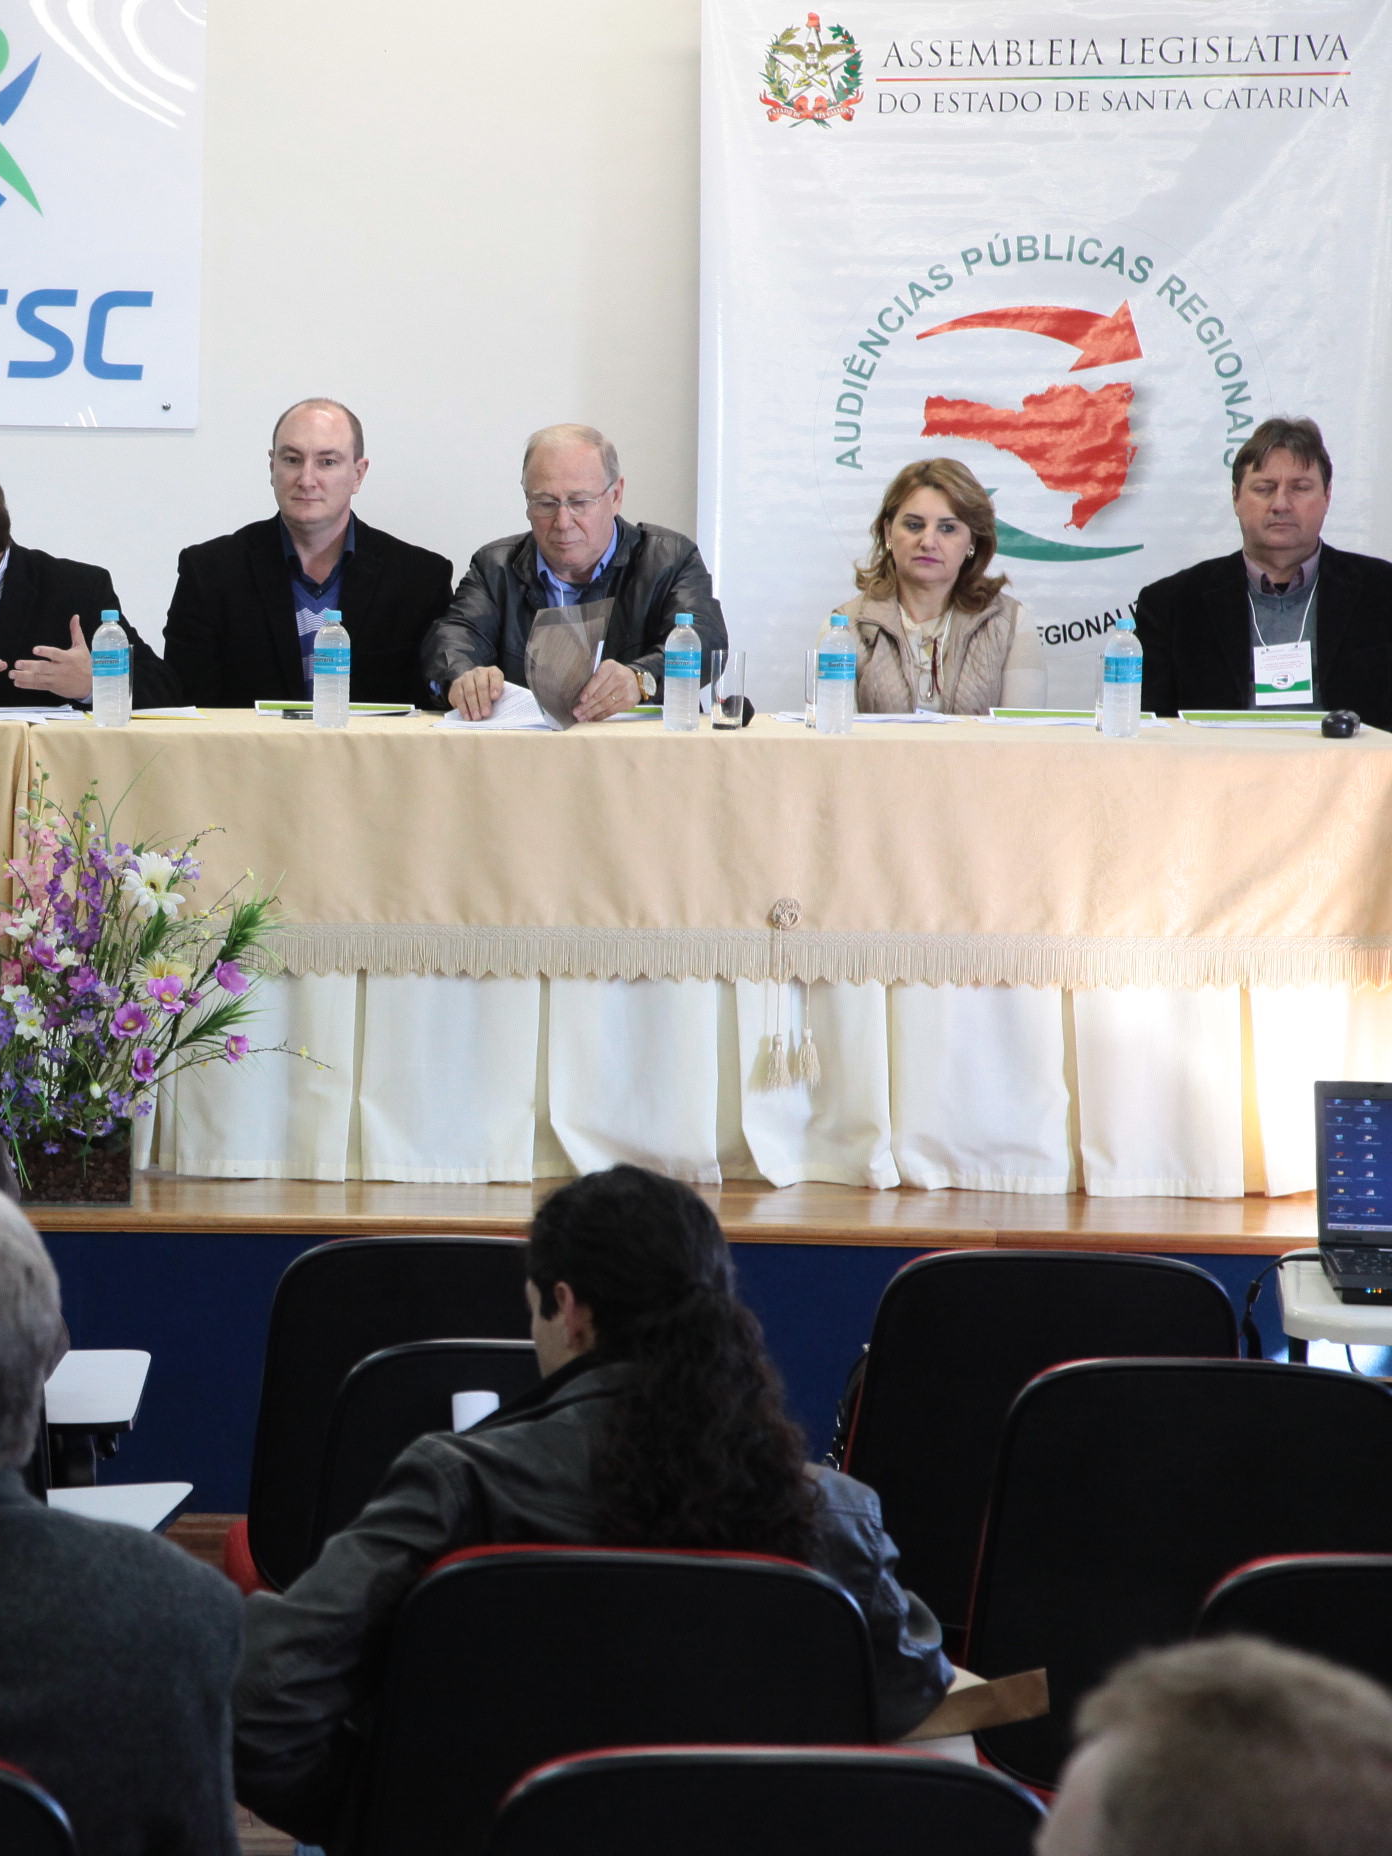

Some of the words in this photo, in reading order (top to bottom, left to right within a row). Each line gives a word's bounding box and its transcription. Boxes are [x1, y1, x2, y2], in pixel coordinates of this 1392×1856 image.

[882, 37, 1105, 69] ASSEMBLEIA
[1119, 32, 1351, 65] LEGISLATIVA
[877, 92, 921, 115] DO
[933, 90, 1043, 114] ESTADO
[1054, 89, 1091, 113] DE
[1101, 87, 1194, 112] SANTA
[1203, 85, 1351, 110] CATARINA
[834, 262, 955, 471] AUDIÊNCIAS
[960, 232, 1155, 285] PÚBLICAS
